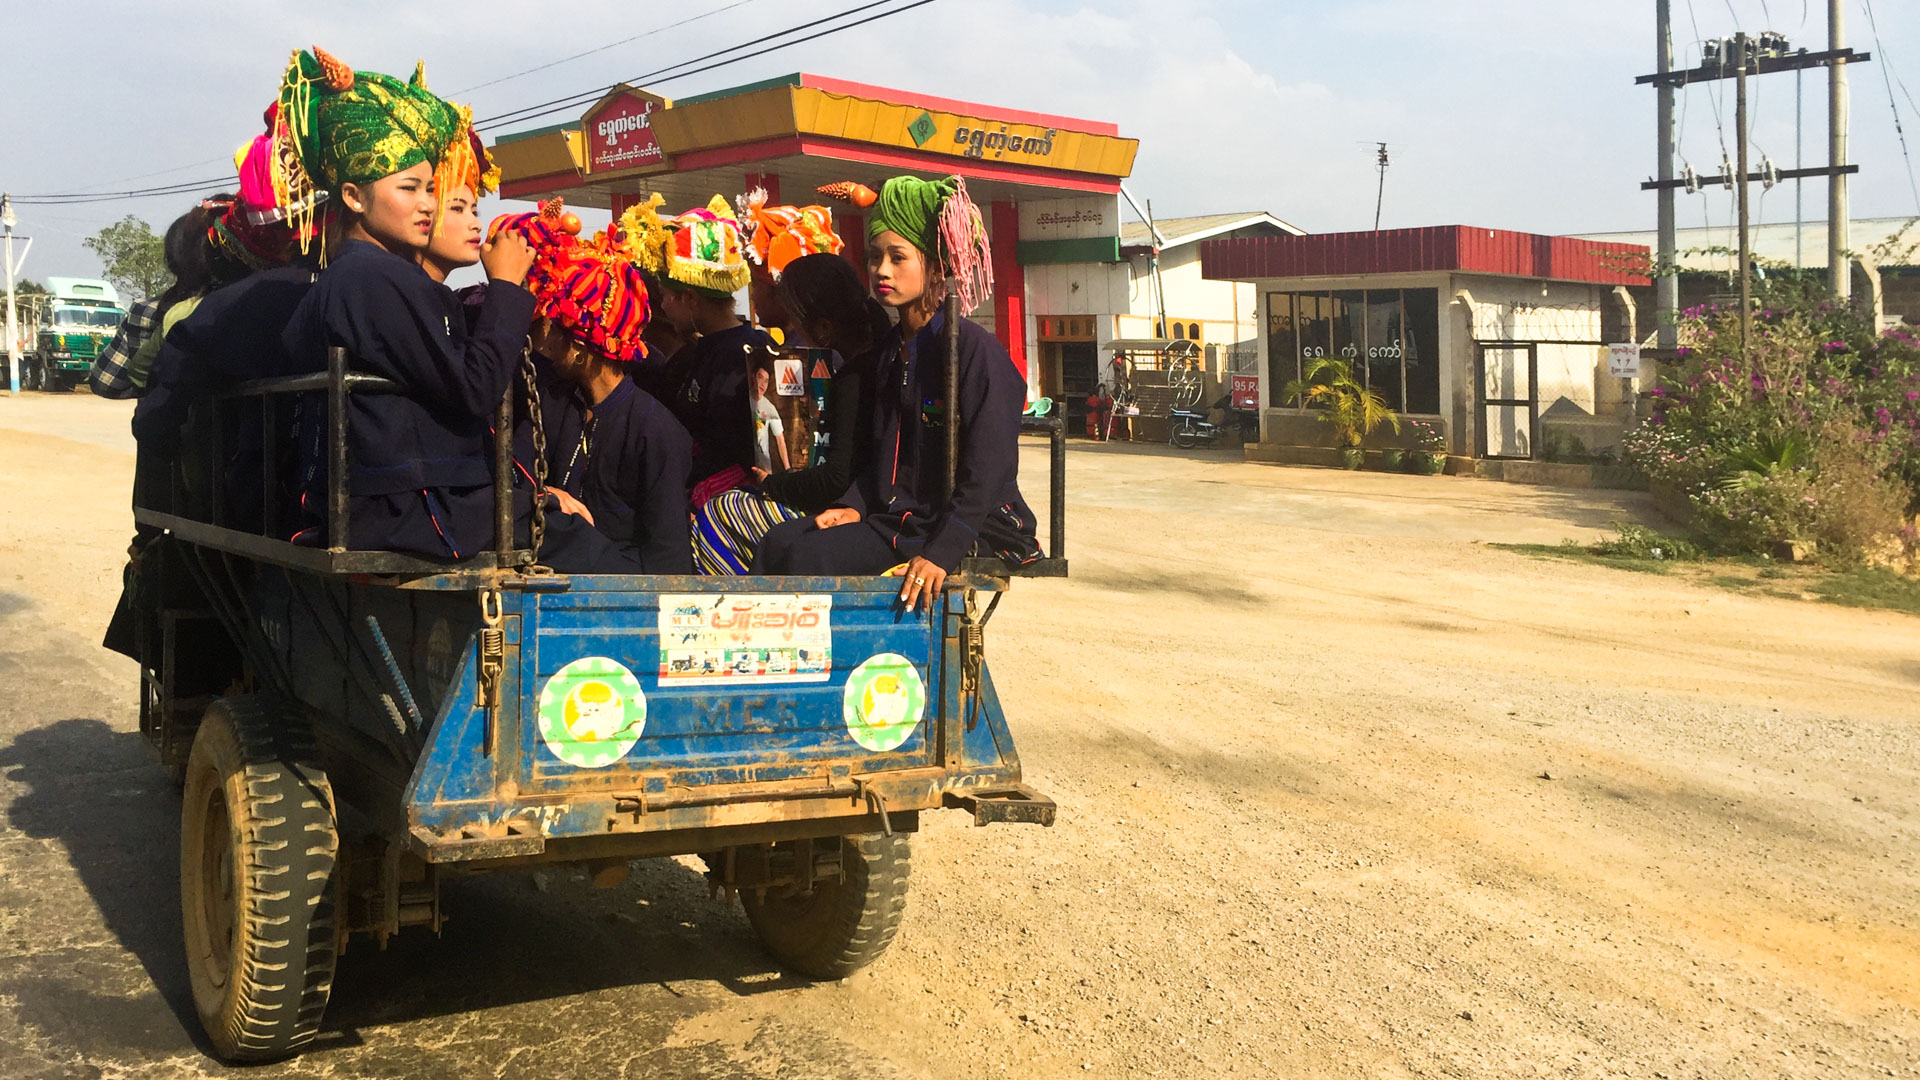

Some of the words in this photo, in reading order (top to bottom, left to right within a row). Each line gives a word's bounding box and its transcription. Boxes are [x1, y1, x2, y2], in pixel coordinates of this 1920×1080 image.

[598, 101, 653, 146] ရွှေကံ့ကေ်
[595, 142, 662, 167] စက်သုံးဆီရောင်းဝယ်ရေ
[1234, 380, 1246, 392] 95
